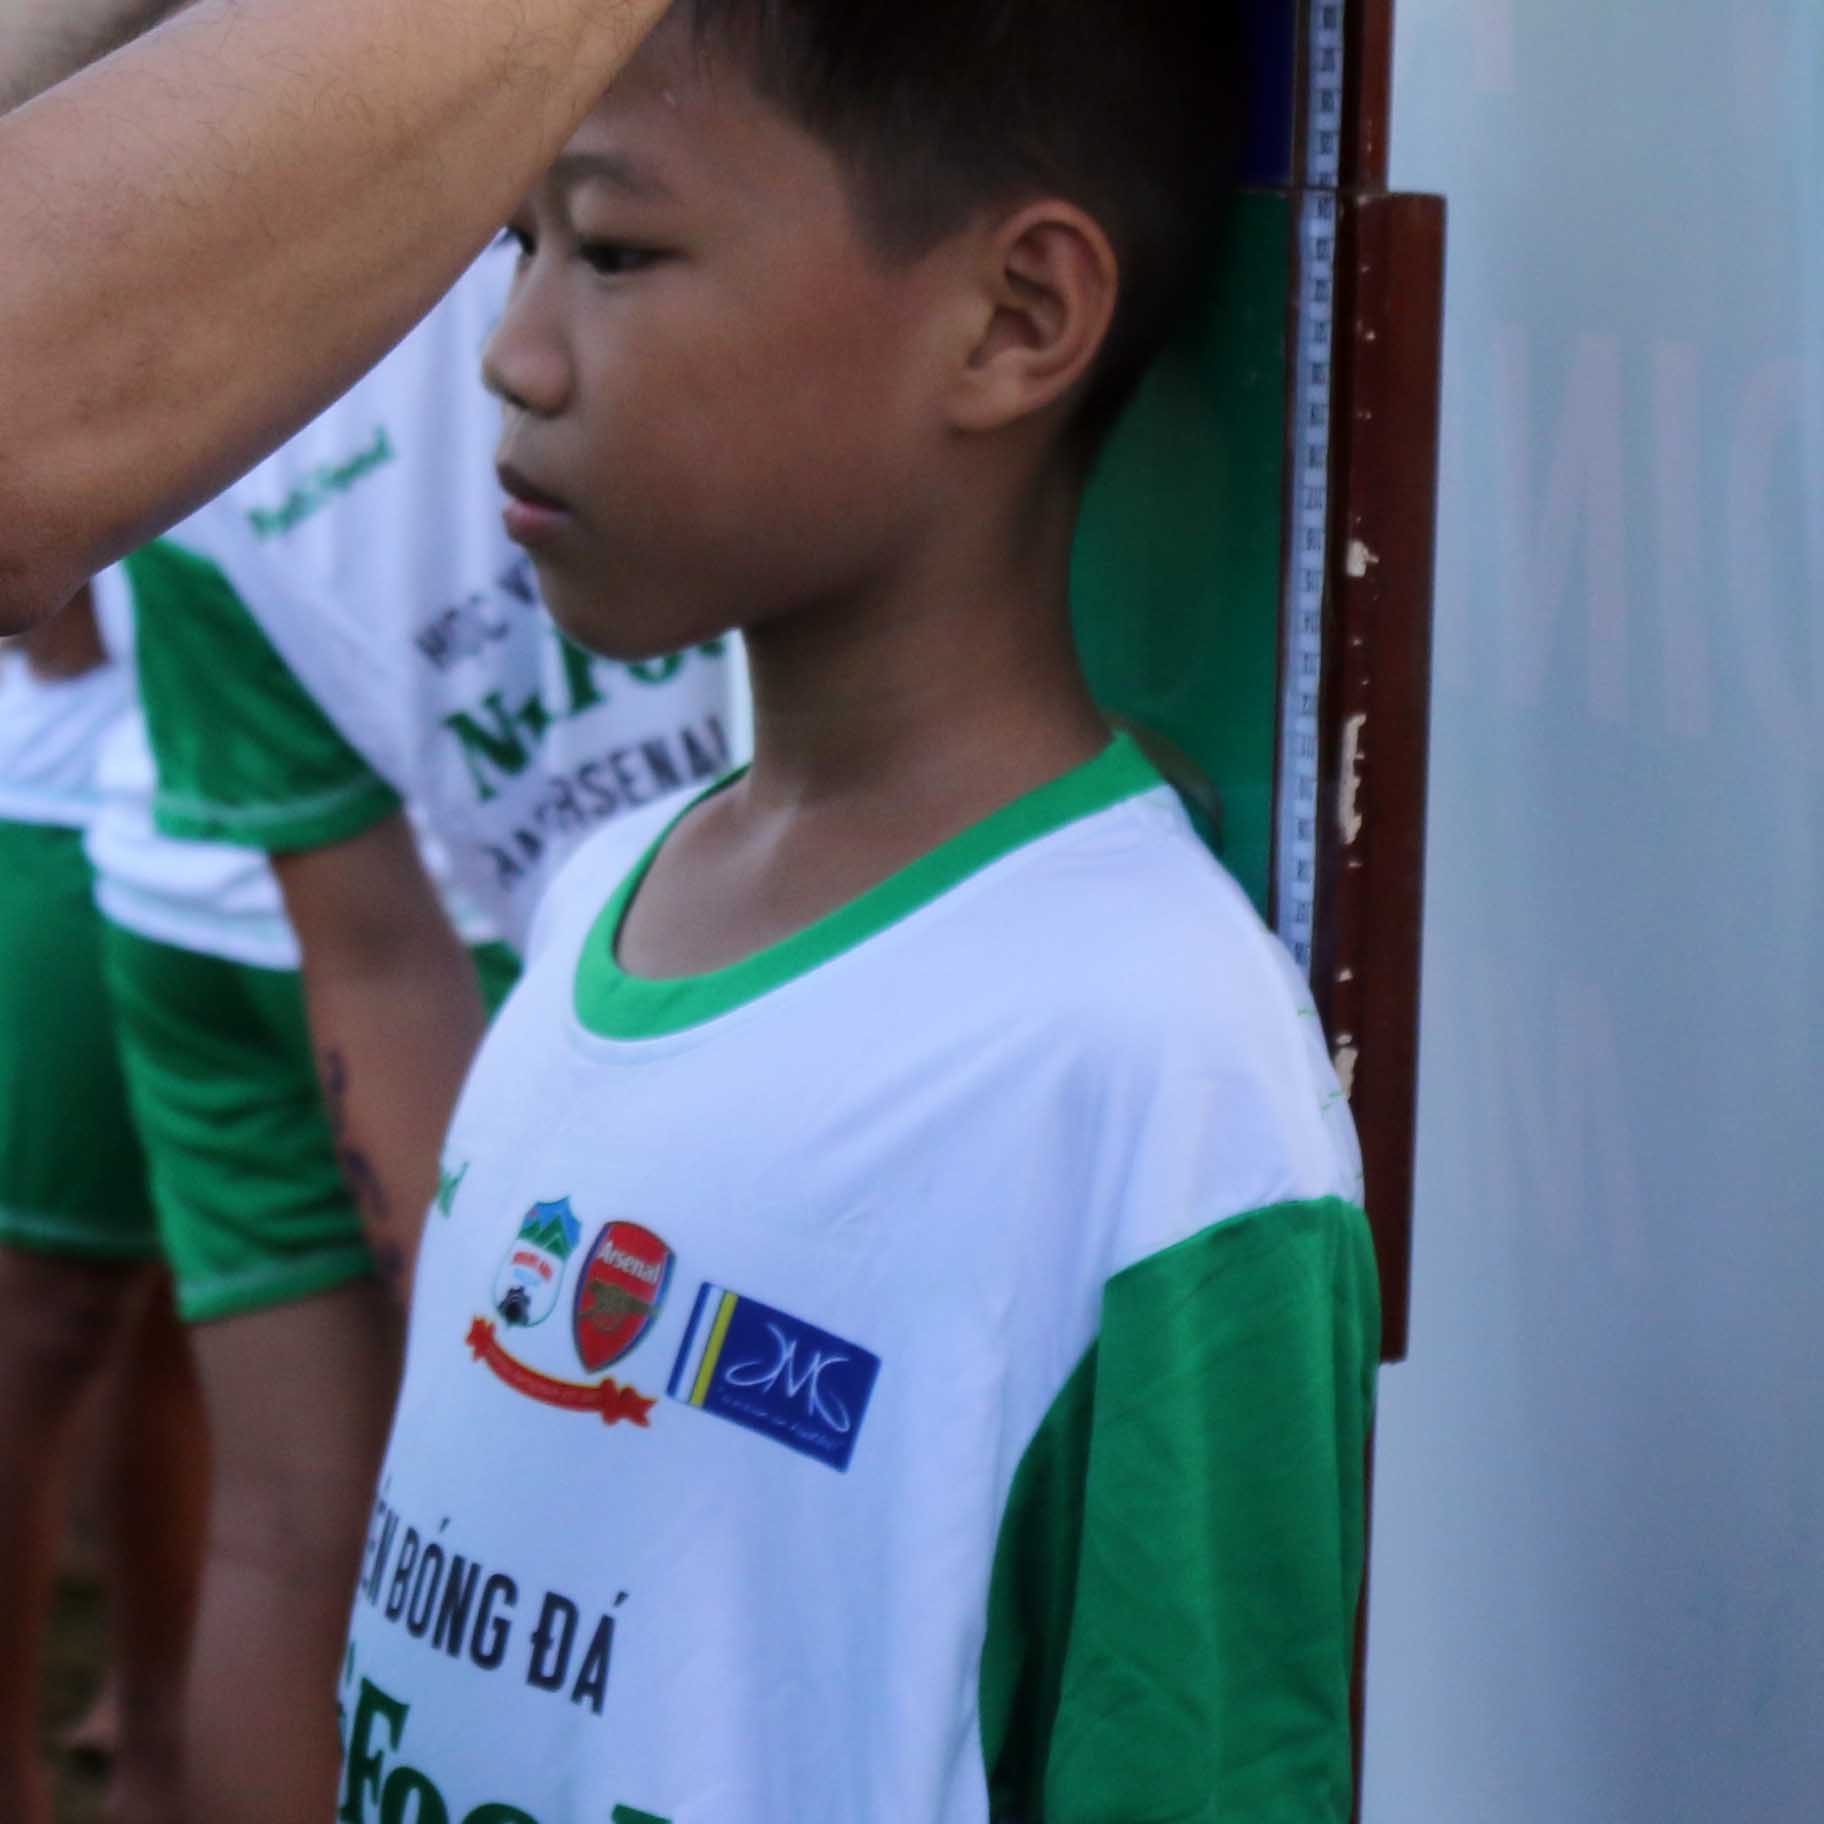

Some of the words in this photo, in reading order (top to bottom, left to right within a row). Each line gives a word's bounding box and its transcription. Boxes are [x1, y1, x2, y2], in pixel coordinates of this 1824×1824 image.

[596, 1240, 664, 1287] Arsenal
[385, 1516, 518, 1672] BÓNG
[526, 1589, 629, 1716] ĐÁ
